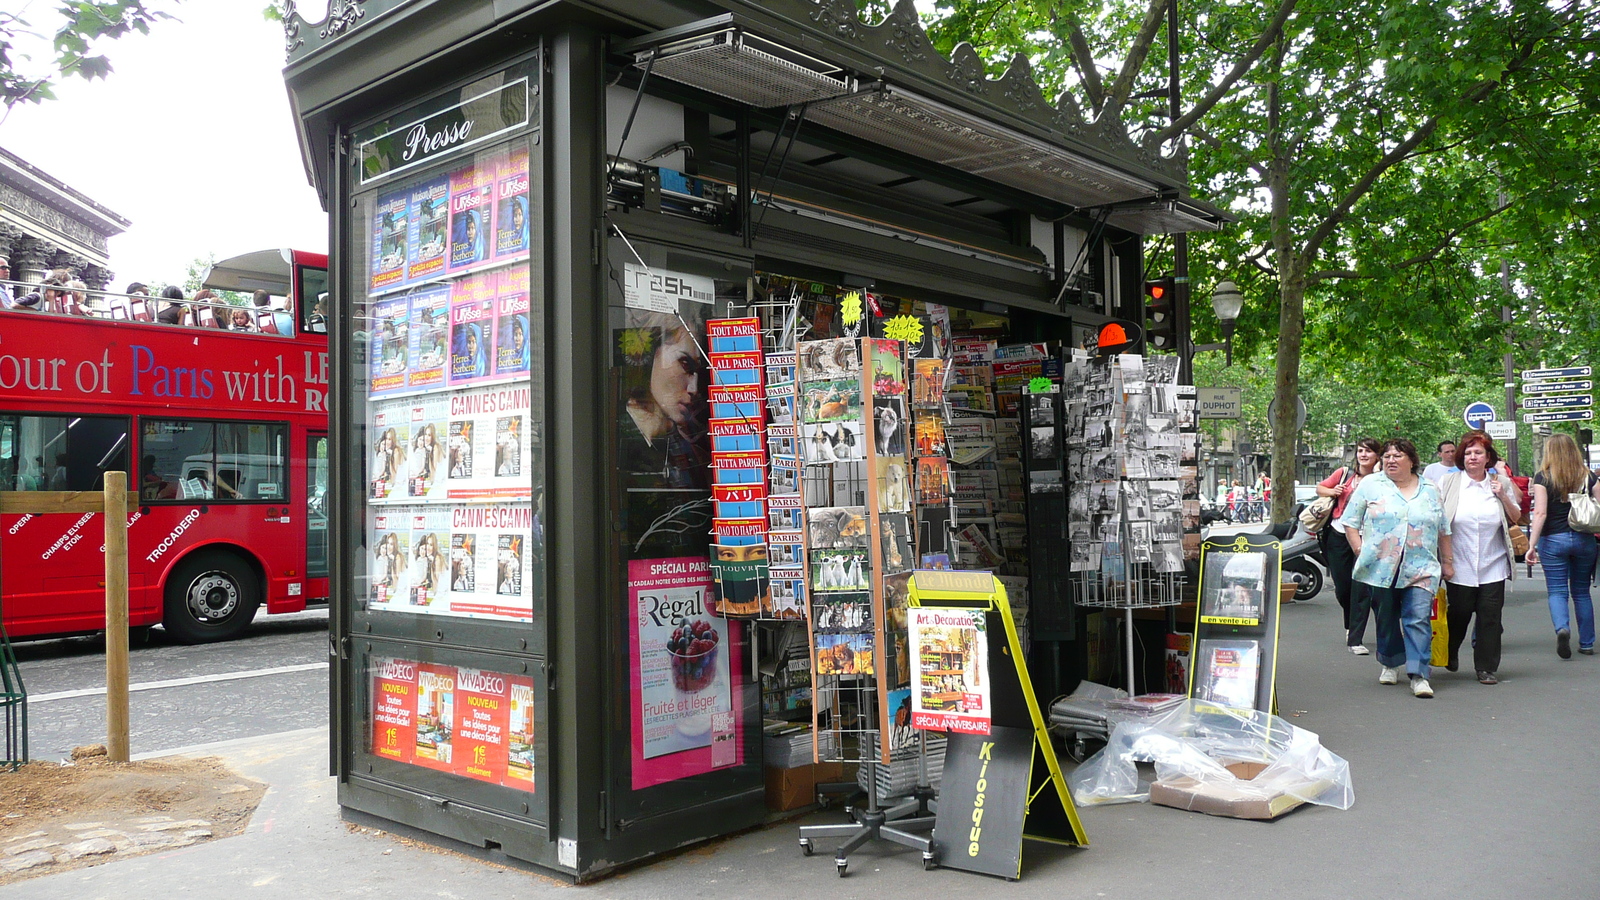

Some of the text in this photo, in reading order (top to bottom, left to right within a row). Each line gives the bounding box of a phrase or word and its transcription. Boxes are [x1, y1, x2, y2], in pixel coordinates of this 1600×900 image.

[402, 120, 475, 161] Presse
[500, 179, 528, 198] Ulysse
[454, 193, 481, 212] Ulysse
[624, 268, 693, 297] rash
[500, 297, 529, 315] Ulysse
[455, 307, 482, 323] Ulysse
[712, 325, 755, 336] TOUT PARIS
[717, 358, 755, 369] ALL PARIS
[769, 356, 796, 364] PARIS
[0, 343, 298, 403] our of Paris with
[451, 392, 496, 416] CANNES
[499, 389, 530, 411] CANN
[713, 391, 757, 402] TODO PARIS
[1202, 402, 1236, 410] DUPHOT
[714, 424, 758, 435] GANZ PARIS
[716, 457, 760, 468] TUTTA PARIGI
[726, 489, 752, 501] パリ
[772, 498, 799, 506] PARIS
[9, 513, 33, 535] OPERA
[453, 507, 498, 528] CANNES
[500, 508, 531, 529] CANN
[42, 512, 95, 560] CHAMPS ELYSEES
[63, 533, 83, 552] ETOIL
[146, 508, 200, 564] TROCADERO
[650, 560, 711, 575] SPÉCIAL PARI
[633, 579, 654, 587] CADEAU
[920, 571, 990, 589] Le Monde
[640, 589, 703, 627] Régal
[917, 613, 929, 624] Art
[375, 660, 414, 681] VIVADÉCO
[381, 682, 409, 695] NOUVEAU
[419, 673, 454, 691] VIVADÉCO
[459, 672, 505, 694] VIVADÉCO
[385, 694, 403, 706] Toutes
[467, 696, 499, 710] NOUVEAU
[643, 694, 717, 717] Fruité et léger
[385, 703, 398, 715] idées
[398, 709, 411, 718] pour
[385, 714, 397, 724] déco
[473, 708, 491, 721] Toutes
[653, 713, 678, 723] RECETTES
[463, 717, 501, 735] les idées pour
[916, 714, 988, 732] SPÉCIAL ANNIVERSAIRE
[460, 730, 471, 738] une
[471, 730, 485, 741] déco
[380, 746, 402, 758] seulement
[467, 765, 491, 777] seulement
[968, 741, 995, 857] Kiosque
